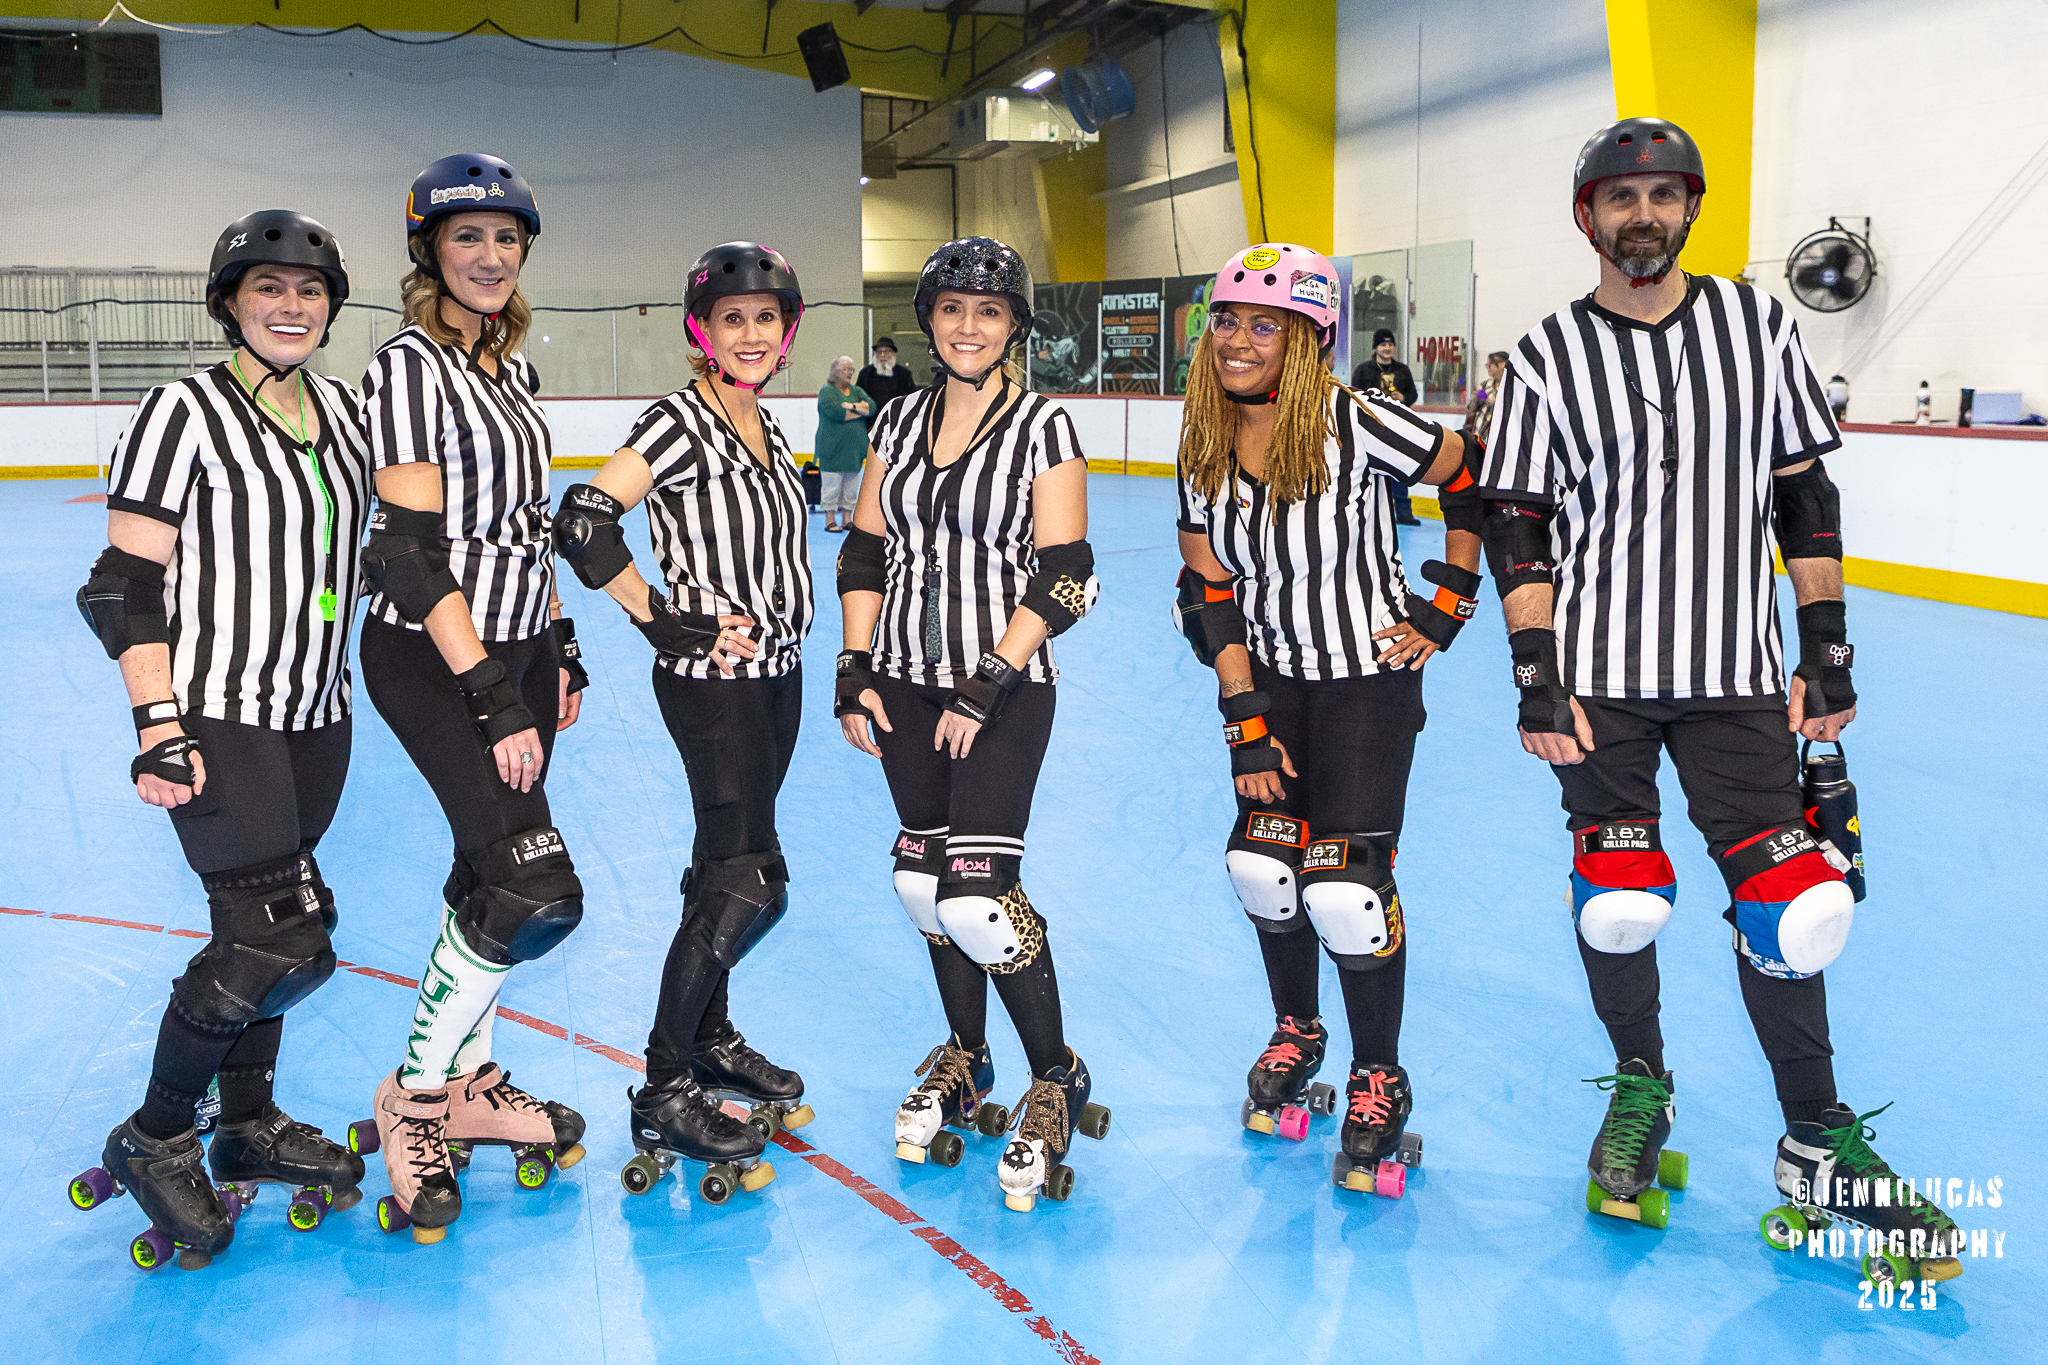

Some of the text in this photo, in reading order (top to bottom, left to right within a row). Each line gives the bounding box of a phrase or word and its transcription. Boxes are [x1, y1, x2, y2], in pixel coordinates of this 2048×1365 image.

[1303, 278, 1319, 290] EGA
[1102, 292, 1159, 311] RINKSTER
[1416, 335, 1461, 363] HOME
[580, 487, 614, 508] 187
[598, 502, 614, 514] PADS
[372, 512, 387, 523] 87
[1254, 817, 1297, 836] 187
[1604, 827, 1647, 840] 187
[523, 832, 558, 853] 187
[1252, 828, 1297, 844] KILLER PADS
[1768, 829, 1805, 853] 187
[897, 835, 926, 855] Moxi
[1305, 845, 1339, 860] 187
[1602, 840, 1631, 849] KILLER
[523, 846, 552, 862] KILLER
[1771, 845, 1799, 863] KILLER
[951, 856, 992, 873] Moxi
[1303, 857, 1339, 869] ILLER PADS
[196, 1103, 221, 1115] AKED
